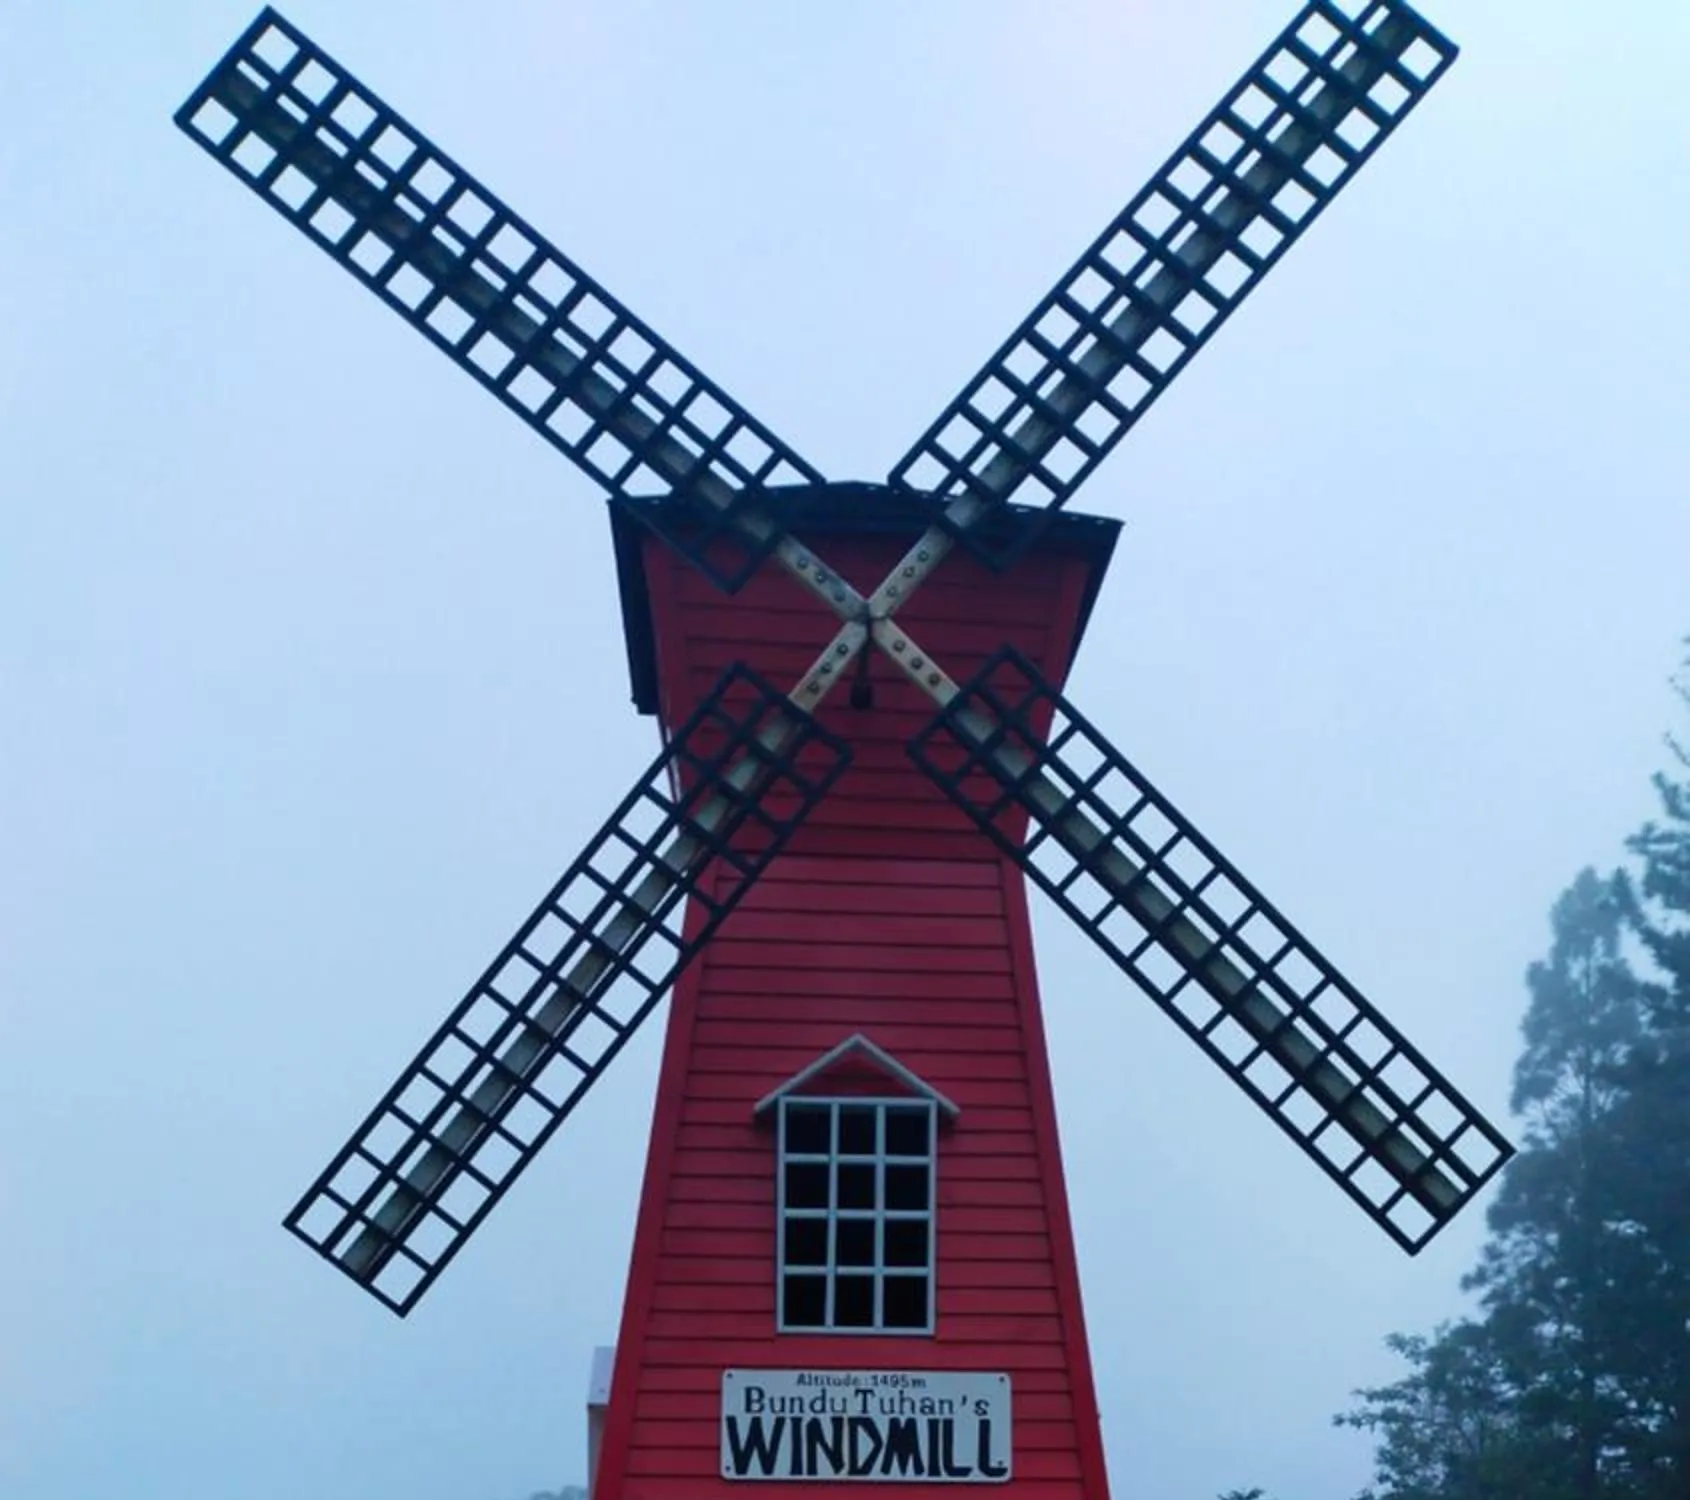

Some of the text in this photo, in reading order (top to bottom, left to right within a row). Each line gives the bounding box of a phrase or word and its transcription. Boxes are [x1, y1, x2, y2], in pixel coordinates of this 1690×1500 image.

[745, 1386, 990, 1416] Bundu Tuhan's
[726, 1416, 1008, 1477] WINDMILL
